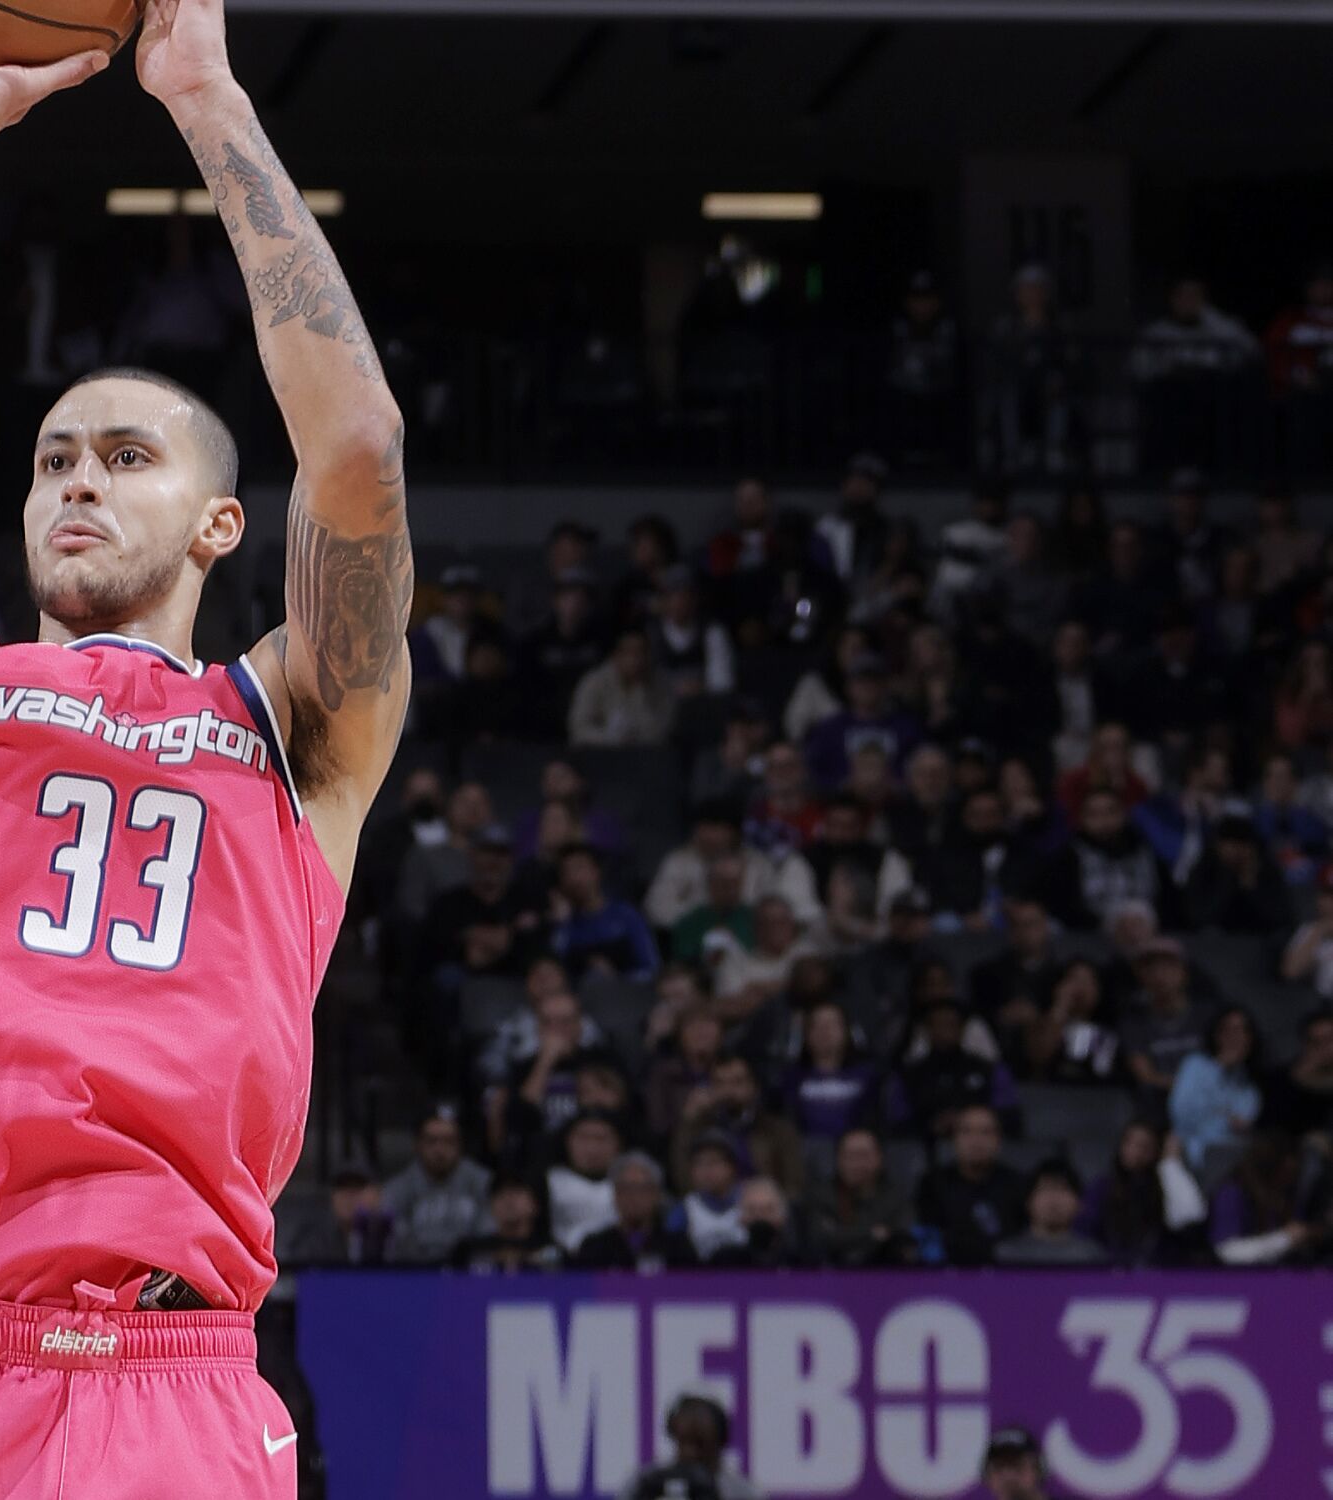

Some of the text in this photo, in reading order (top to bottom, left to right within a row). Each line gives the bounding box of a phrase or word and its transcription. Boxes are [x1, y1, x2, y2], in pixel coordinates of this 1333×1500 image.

[18, 771, 207, 972] 33
[41, 1325, 117, 1351] district
[486, 1298, 991, 1500] MEBO
[1043, 1297, 1275, 1498] 35
